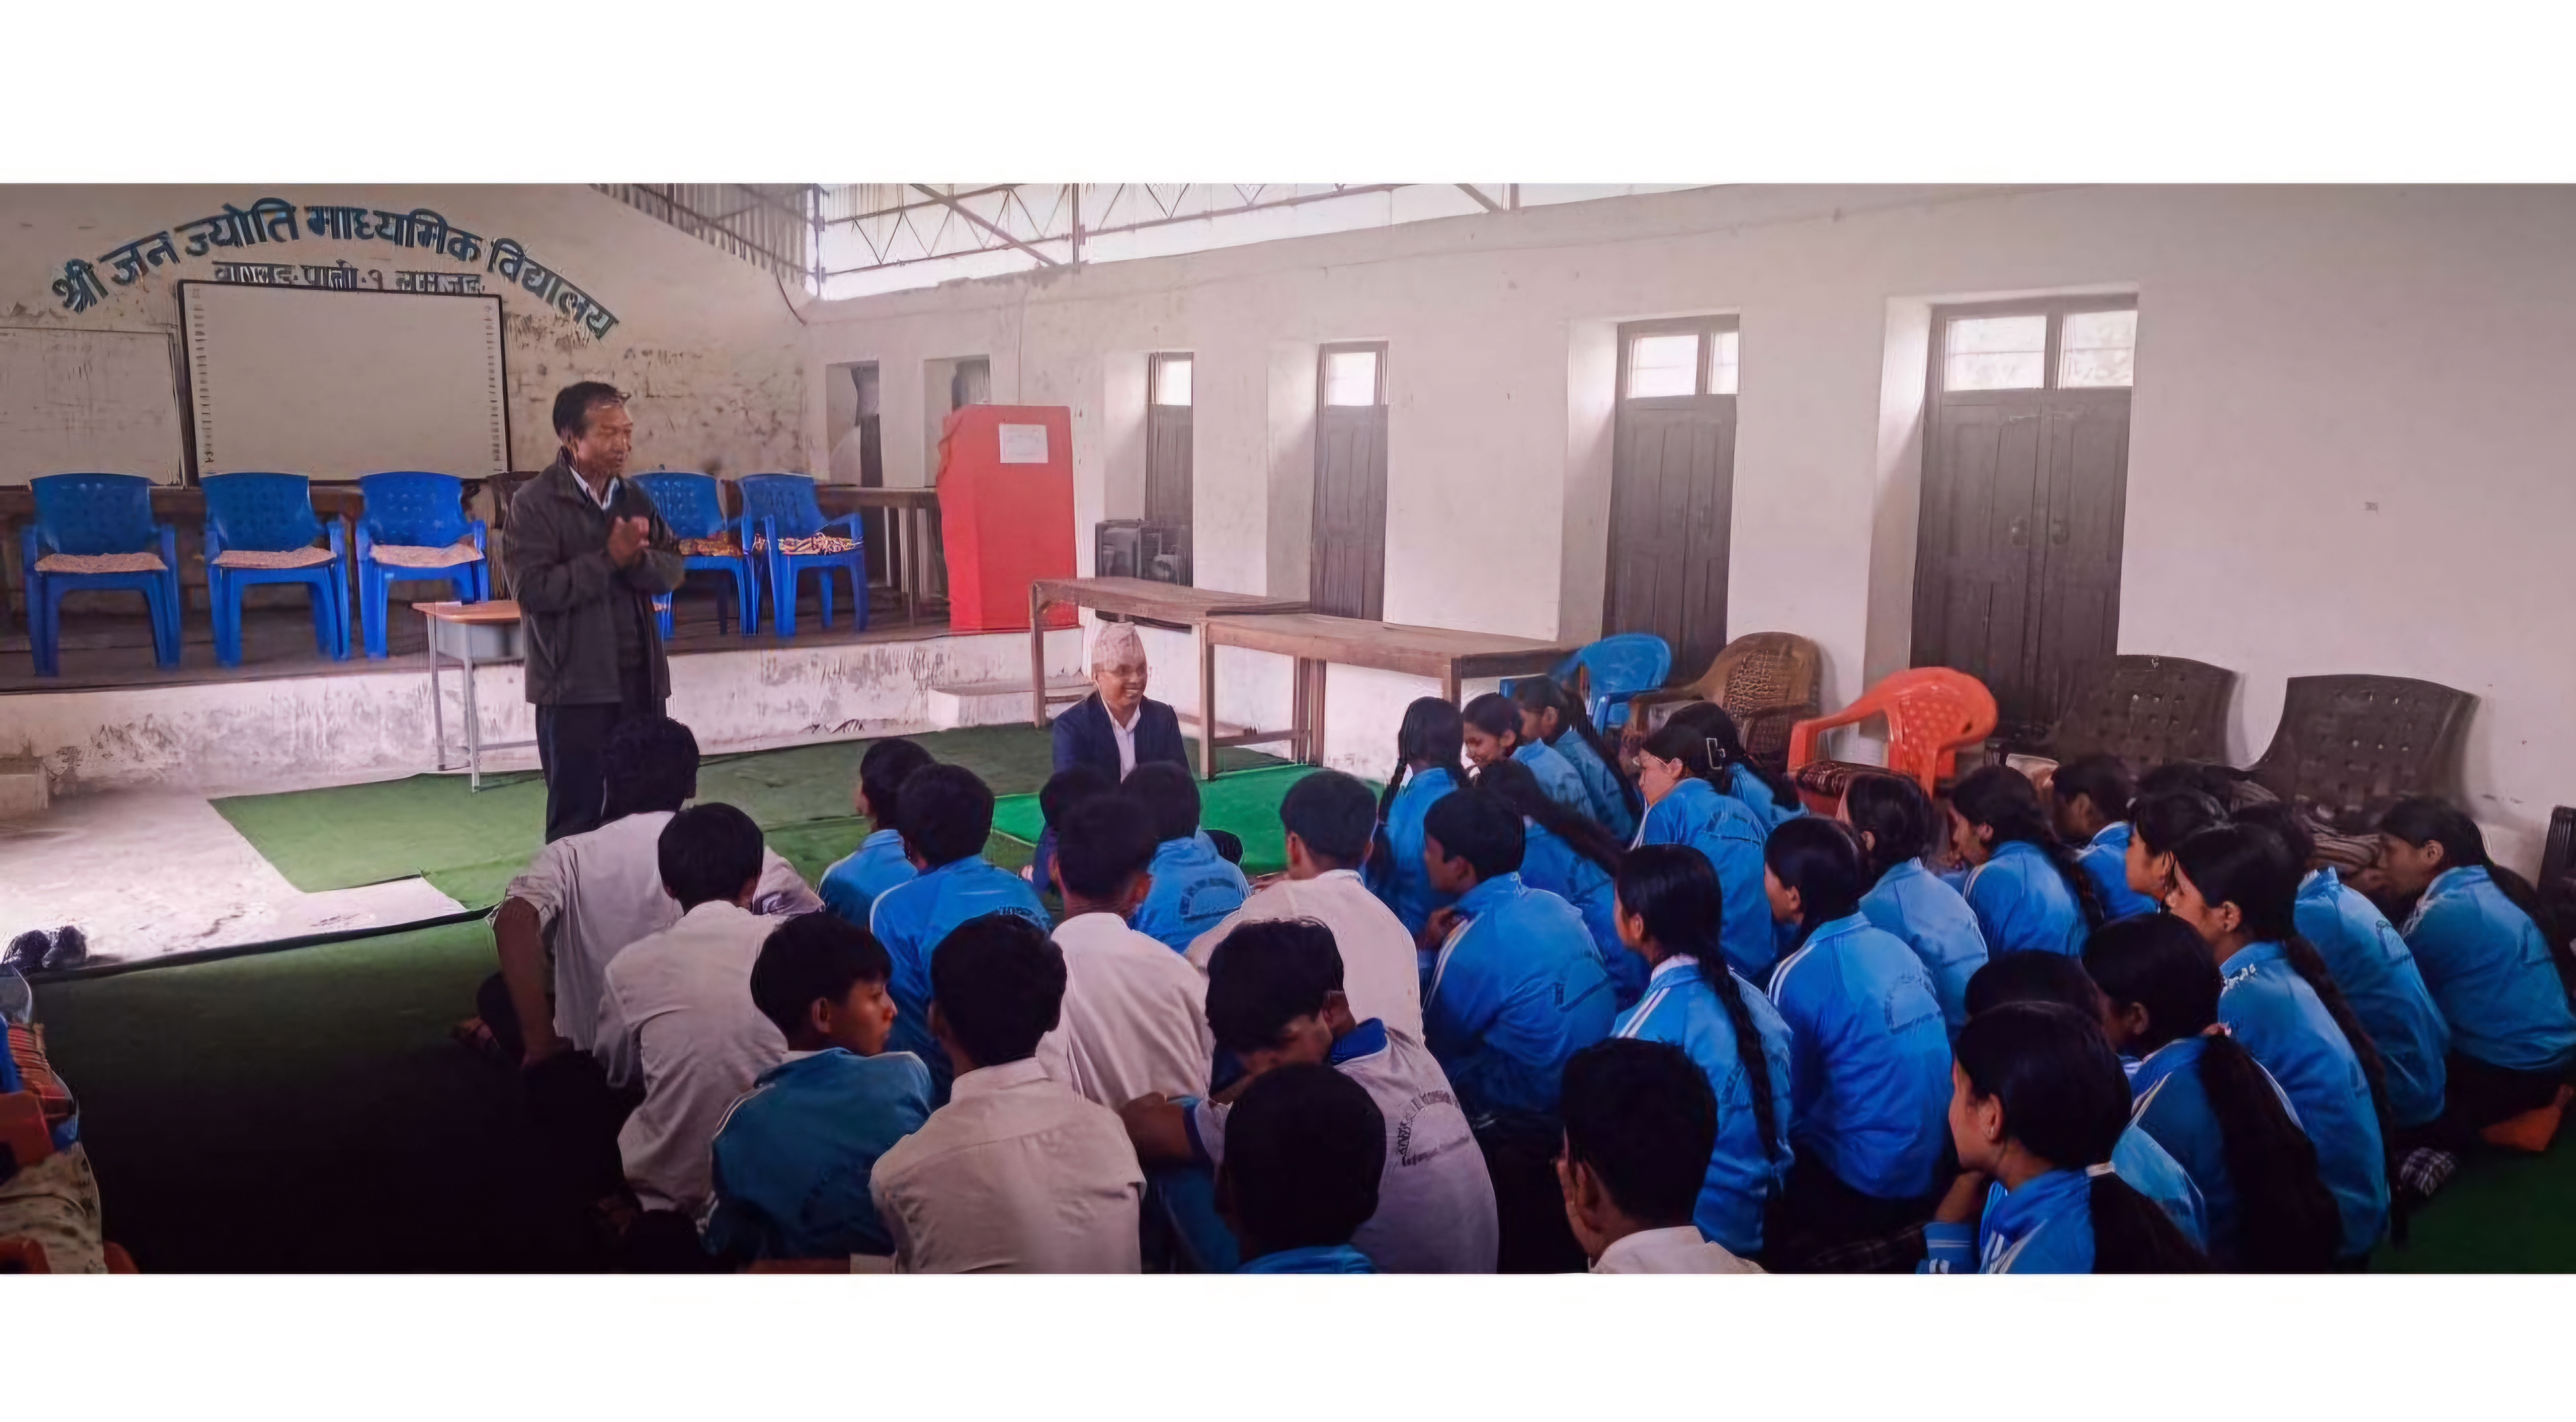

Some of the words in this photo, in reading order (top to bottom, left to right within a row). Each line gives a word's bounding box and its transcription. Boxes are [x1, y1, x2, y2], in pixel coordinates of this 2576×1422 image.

[52, 259, 109, 314] श्री
[96, 231, 180, 286] जन
[174, 197, 299, 256] ज्योति
[304, 206, 483, 262] माध्यमिक
[486, 237, 620, 340] विद्यालय
